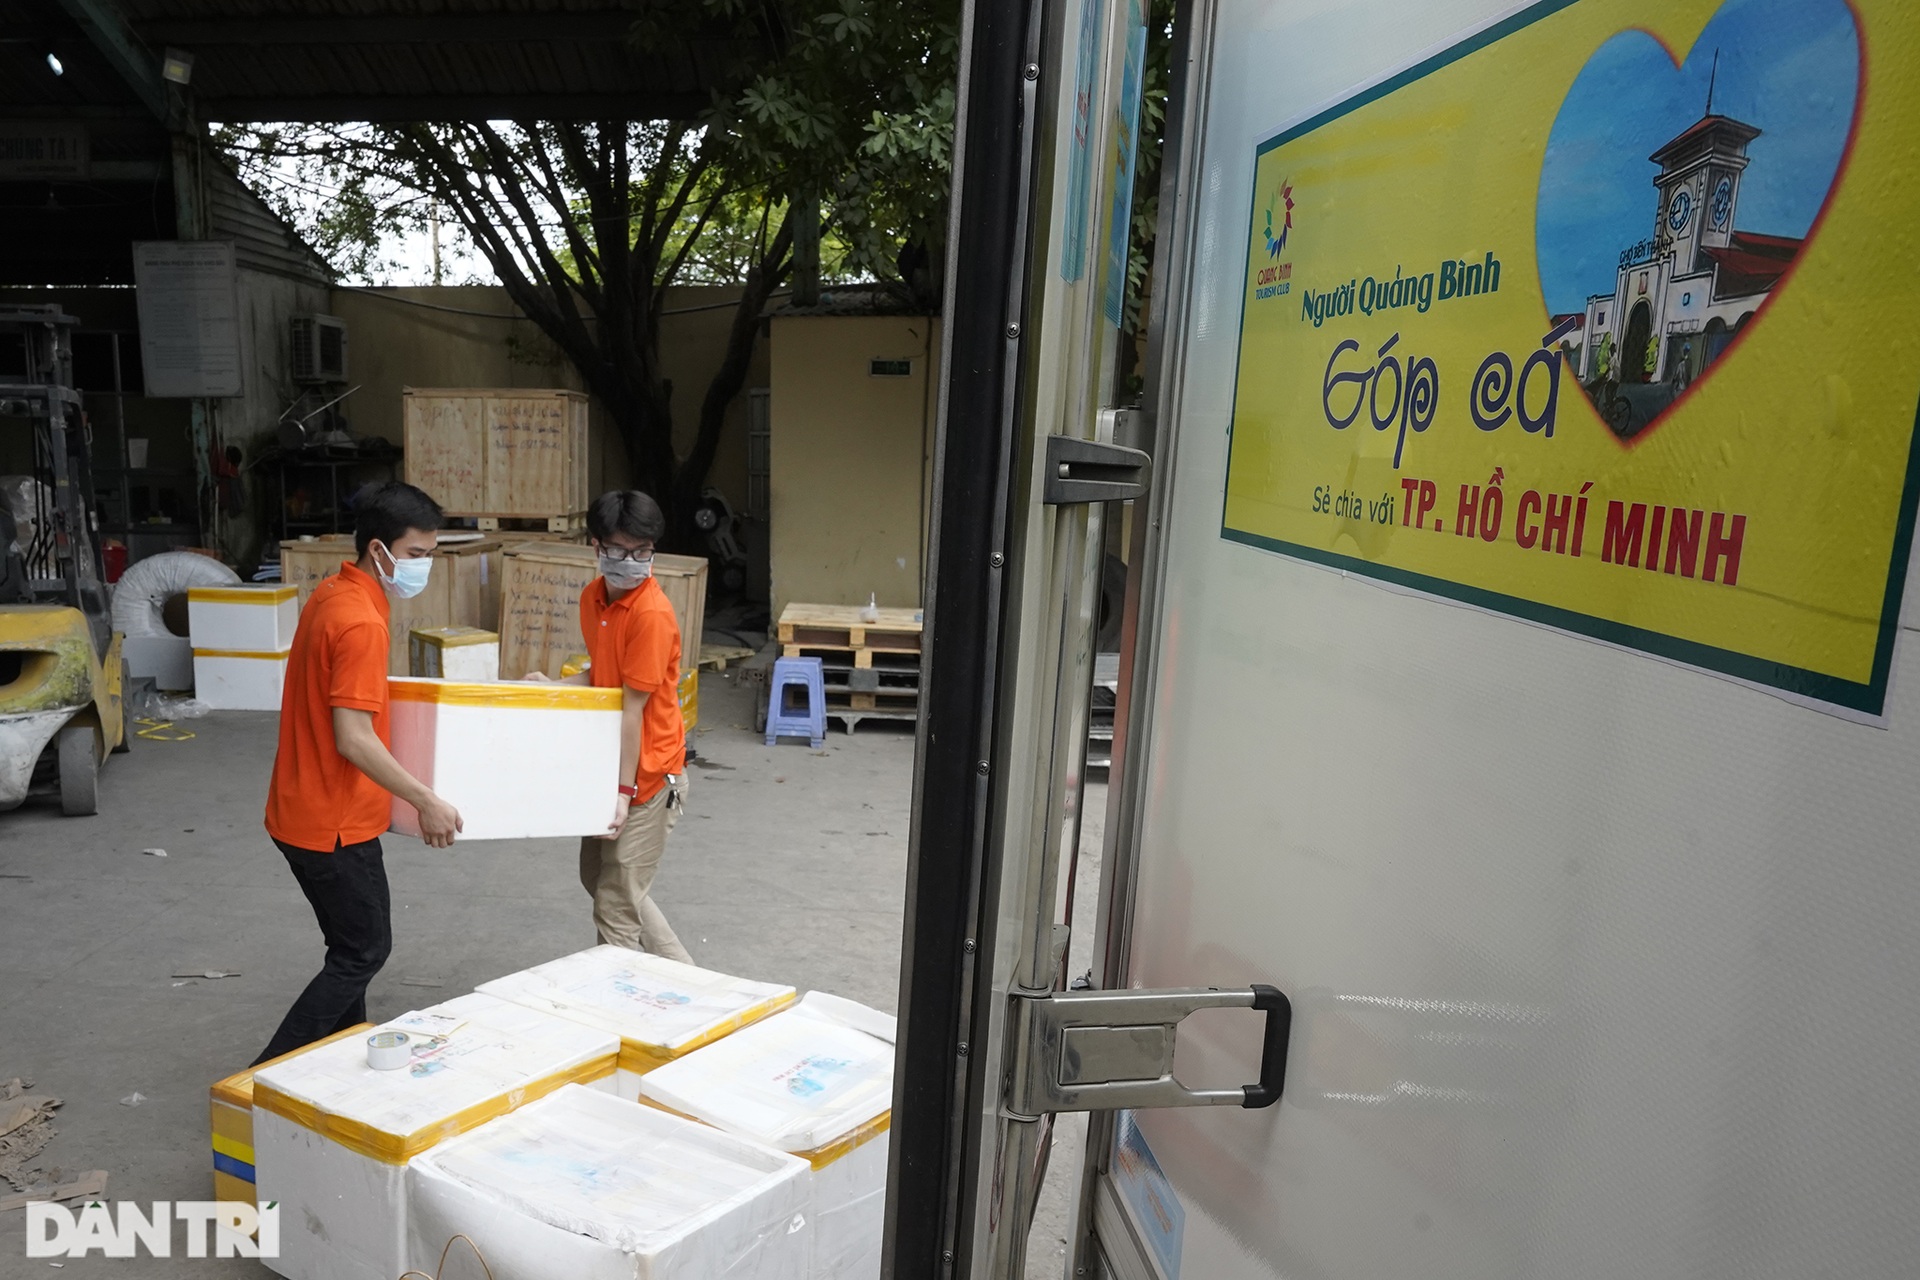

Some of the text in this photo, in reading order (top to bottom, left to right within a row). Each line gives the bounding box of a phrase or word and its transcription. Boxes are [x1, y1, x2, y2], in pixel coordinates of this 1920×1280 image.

[1277, 282, 1290, 296] CLUB
[1301, 251, 1501, 328] Người Quảng Bình
[1322, 332, 1439, 470] Góp
[1312, 466, 1747, 586] Sẻ chia với TP. HỒ CHÍ MINH
